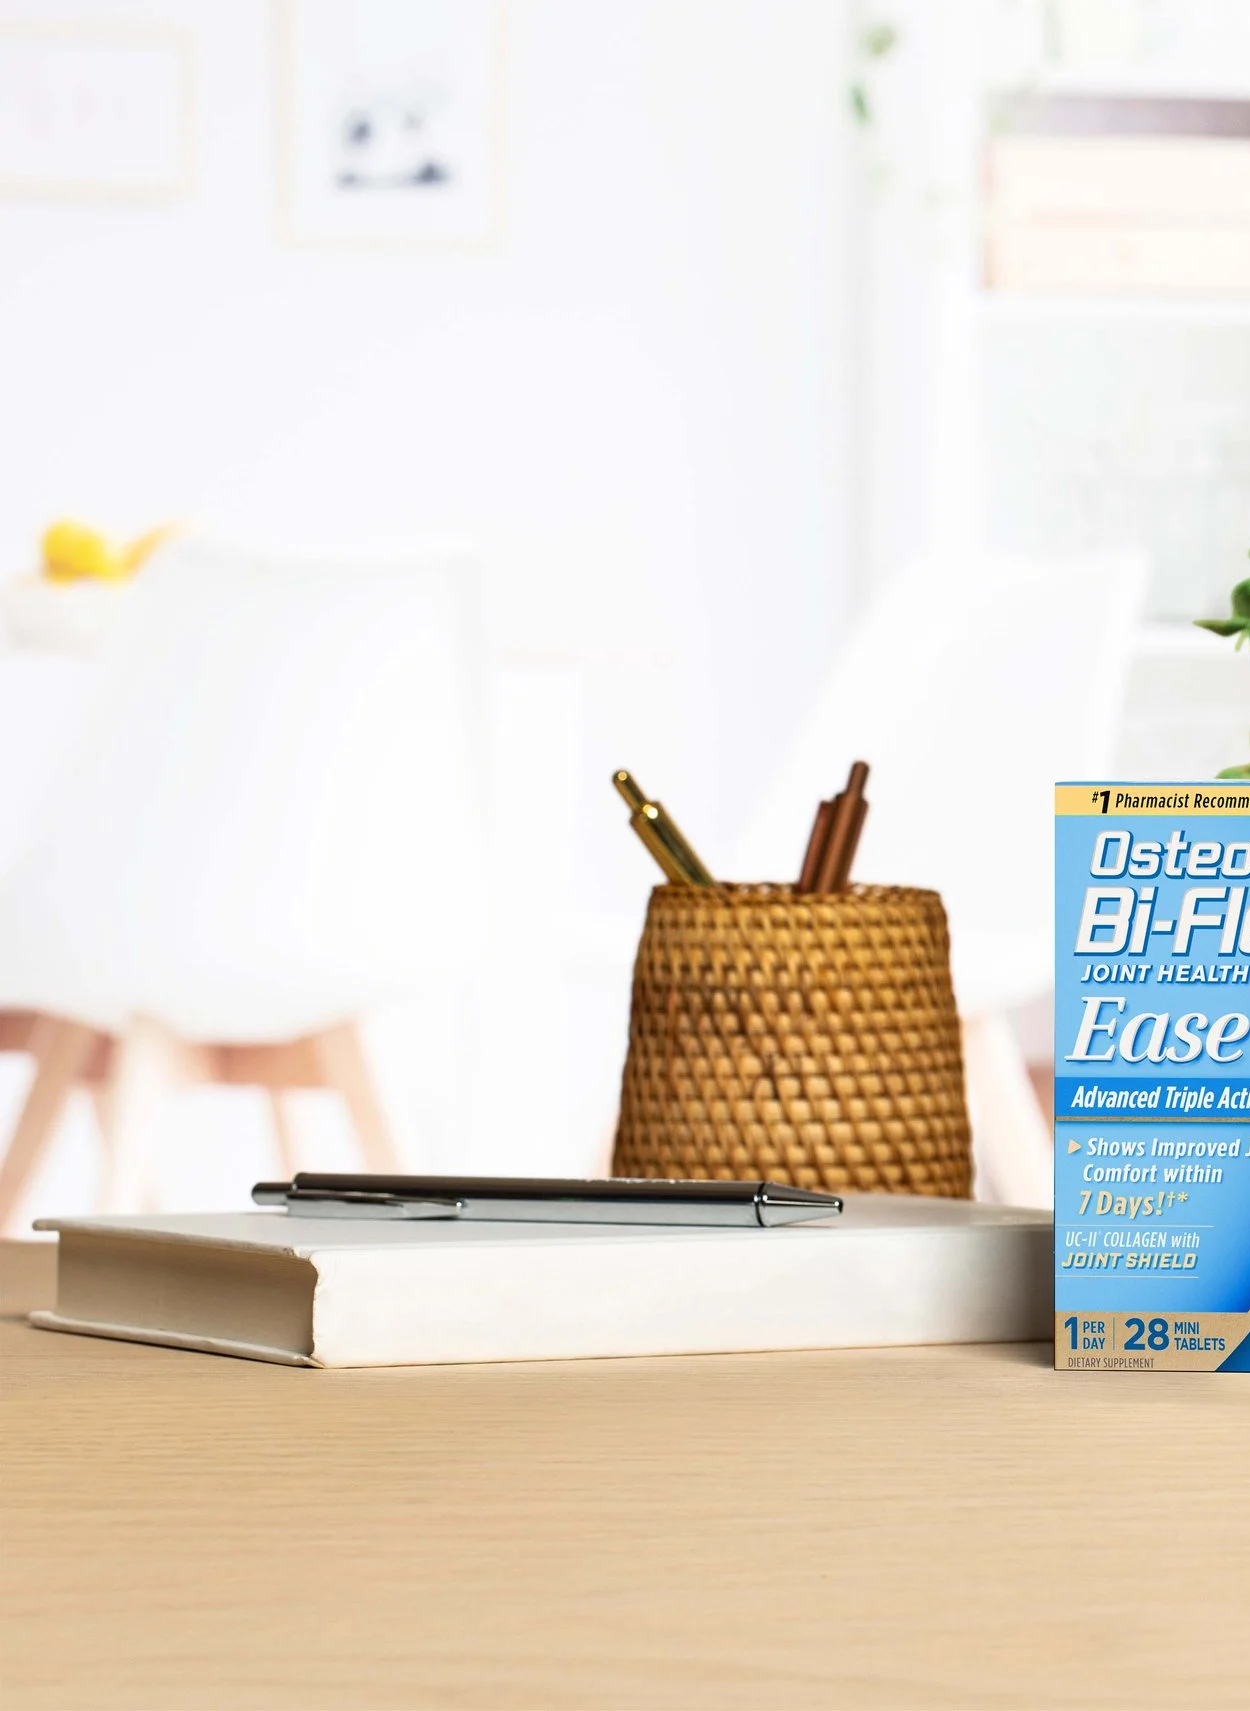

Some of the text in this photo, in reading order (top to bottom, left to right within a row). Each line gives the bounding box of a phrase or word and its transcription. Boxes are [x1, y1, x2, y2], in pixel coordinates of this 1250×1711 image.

[1091, 790, 1110, 814] #1
[1116, 793, 1188, 809] Pharmacist
[1081, 964, 1151, 984] JOINT
[1065, 996, 1250, 1063] Ease
[1071, 1085, 1158, 1109] Advanced
[1162, 1086, 1213, 1112] Triple
[1086, 1137, 1145, 1157] Shows
[1151, 1138, 1240, 1160] Improved
[1083, 1164, 1222, 1184] Comfort within
[1078, 1190, 1093, 1216] 7
[1103, 1231, 1167, 1248] COLLAGEN
[1171, 1232, 1200, 1249] with
[1061, 1252, 1198, 1270] JOINT SHIELD
[1064, 1316, 1106, 1350] 1 PER
[1083, 1337, 1106, 1350] DAY
[1124, 1317, 1200, 1351] 28 MINI
[1174, 1337, 1226, 1351] TABLETS
[1068, 1357, 1155, 1369] DIETARY SUPPLEMENT
